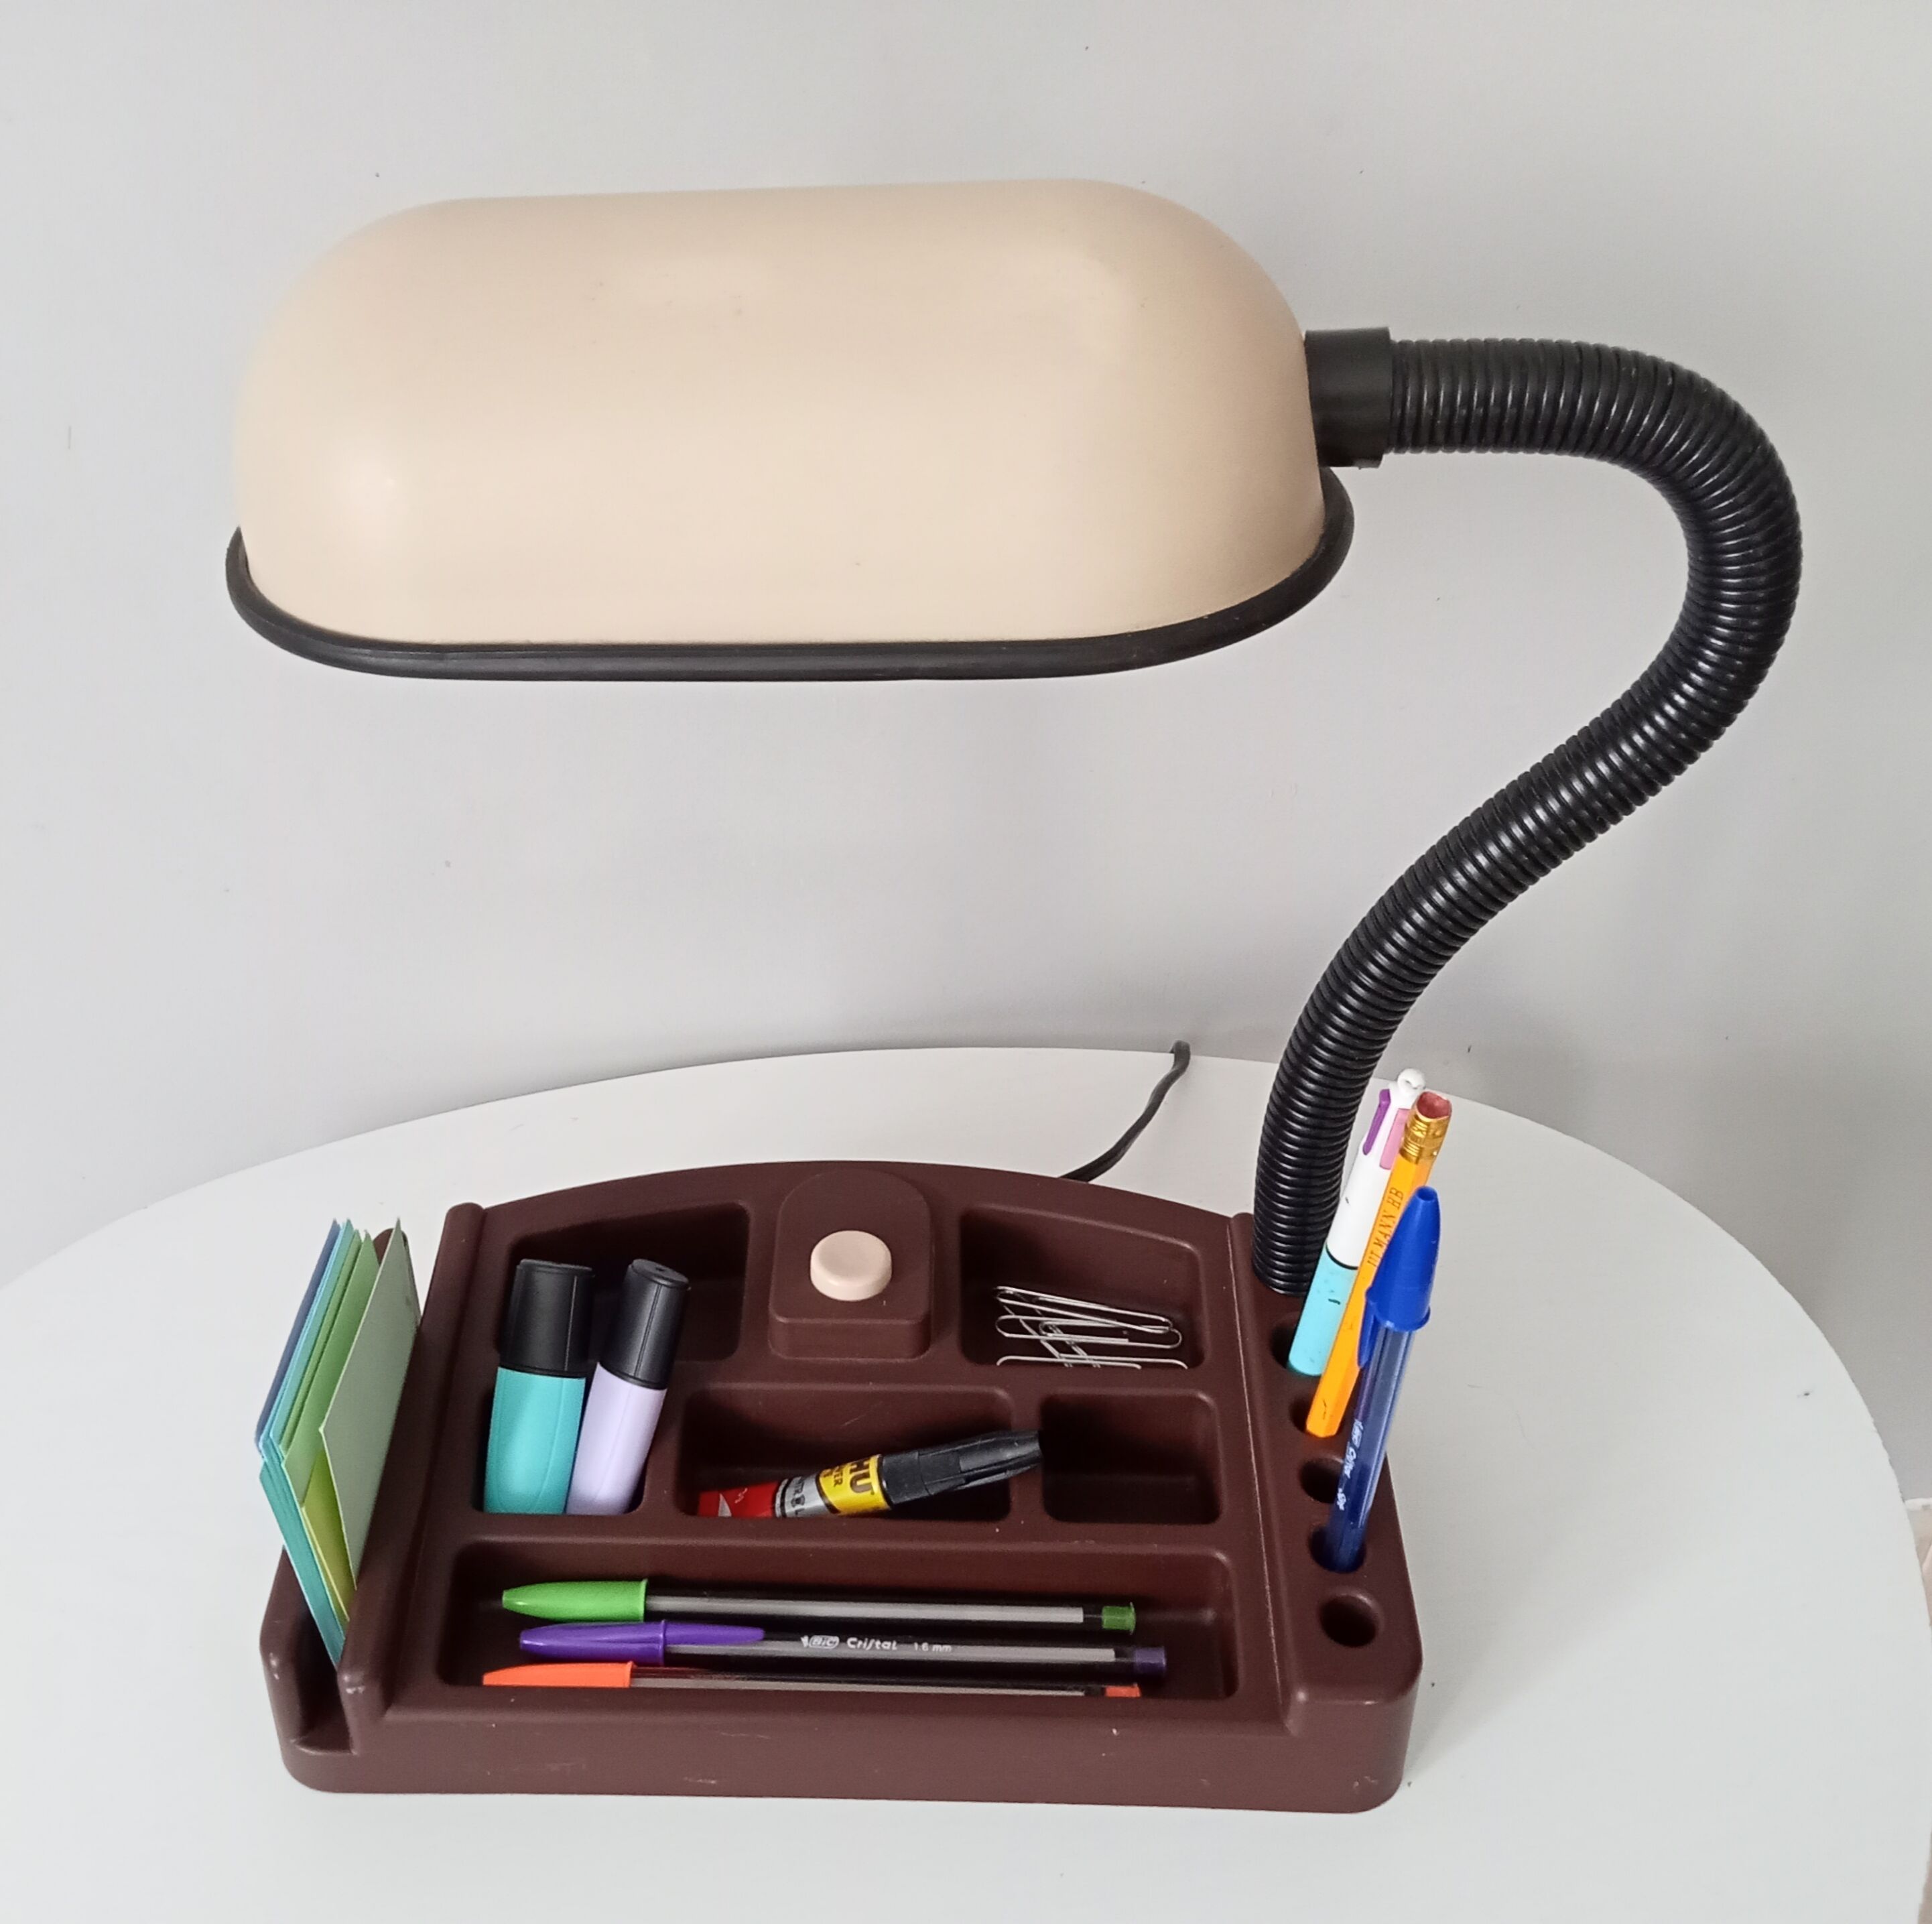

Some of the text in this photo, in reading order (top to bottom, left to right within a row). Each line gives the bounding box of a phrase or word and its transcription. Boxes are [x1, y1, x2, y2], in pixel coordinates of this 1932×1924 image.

[1387, 1187, 1404, 1210] HB
[849, 1457, 873, 1494] HU
[914, 1642, 929, 1651] 1.6
